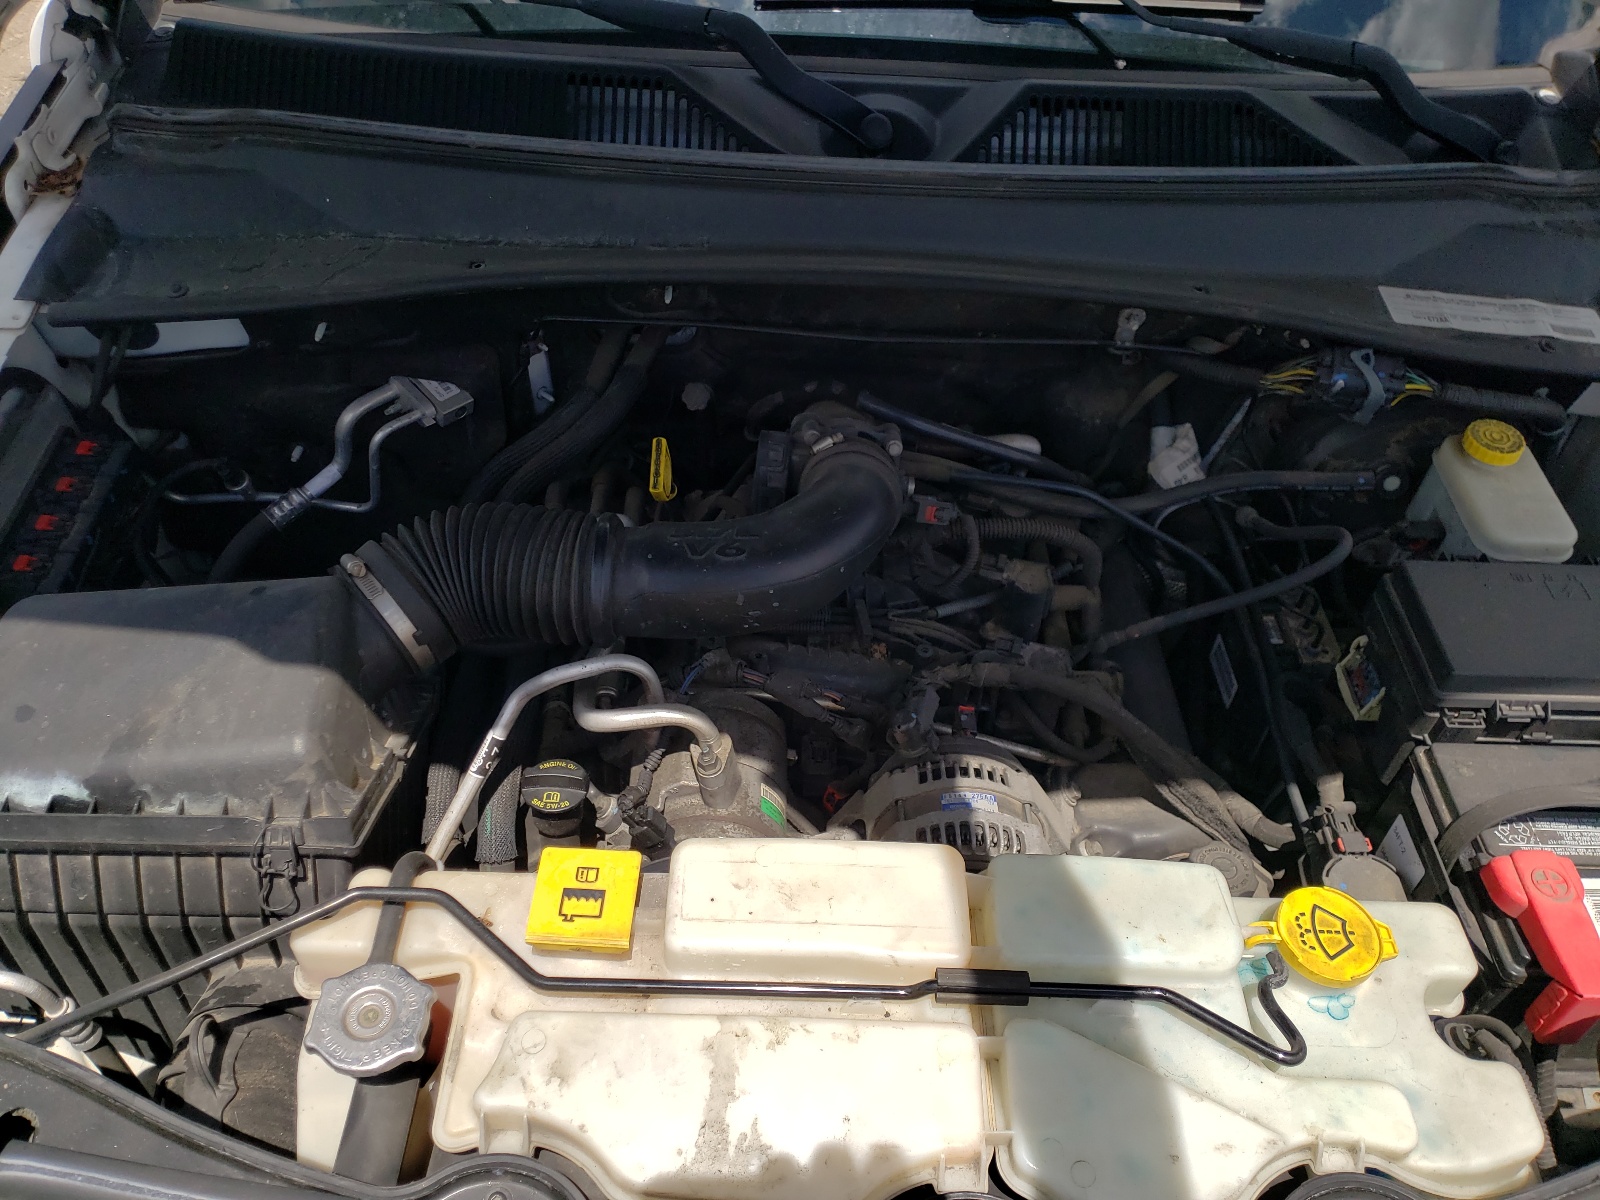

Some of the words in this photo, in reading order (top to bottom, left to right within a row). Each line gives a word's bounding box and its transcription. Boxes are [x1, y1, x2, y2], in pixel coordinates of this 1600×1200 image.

[682, 540, 748, 561] V6
[539, 761, 567, 770] ENGINE
[531, 798, 546, 808] SAE
[546, 800, 570, 809] 5W-20
